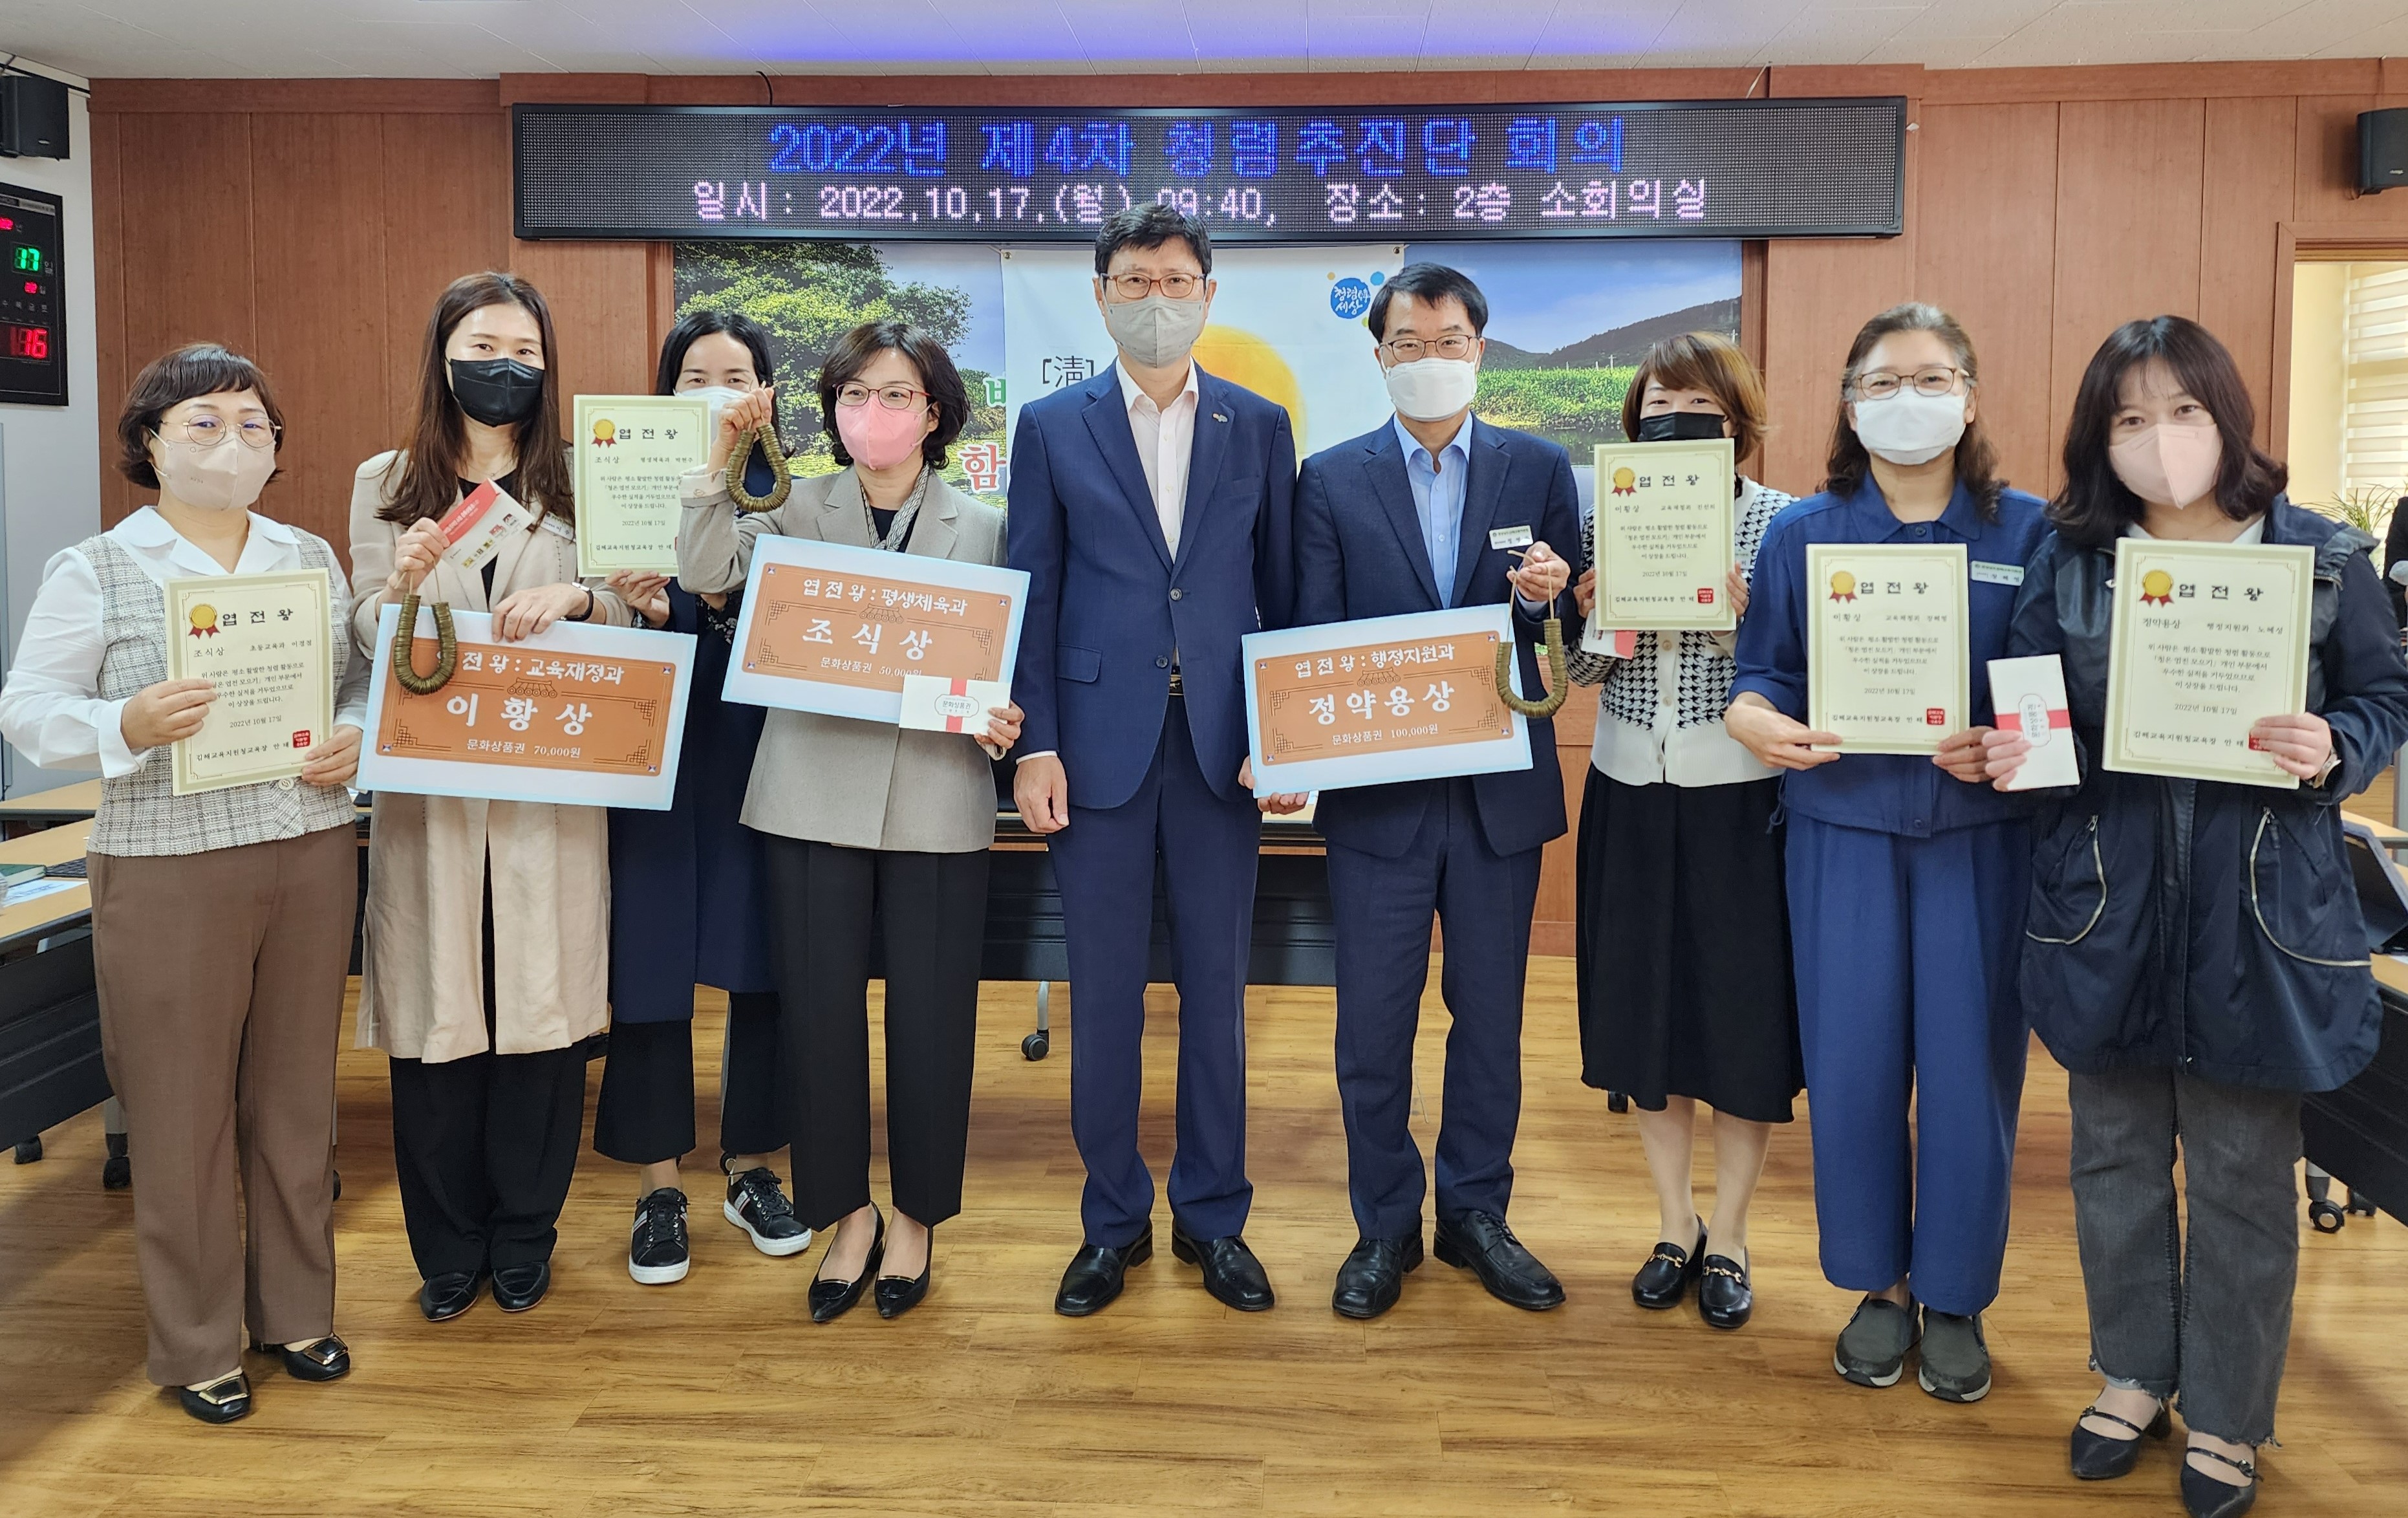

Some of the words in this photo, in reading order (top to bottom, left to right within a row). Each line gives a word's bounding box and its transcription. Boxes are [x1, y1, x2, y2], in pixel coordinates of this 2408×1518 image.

[769, 119, 947, 178] 2022년
[981, 120, 1136, 179] 제4차
[1165, 118, 1476, 179] 청렴추진단
[1505, 116, 1624, 175] 회의
[1454, 182, 1512, 224] 2층
[1540, 179, 1707, 223] 소회의실
[1335, 299, 1362, 315] 세상
[881, 589, 967, 616] 평생체육과
[821, 656, 872, 673] 문화상품권
[1371, 643, 1455, 669] 행정지원과
[526, 658, 624, 685] 교육재정과
[1332, 730, 1382, 746] 문화상품권
[1390, 724, 1439, 739] 100,000원
[466, 739, 526, 755] 문화상품권
[533, 744, 581, 759] 70,000원
